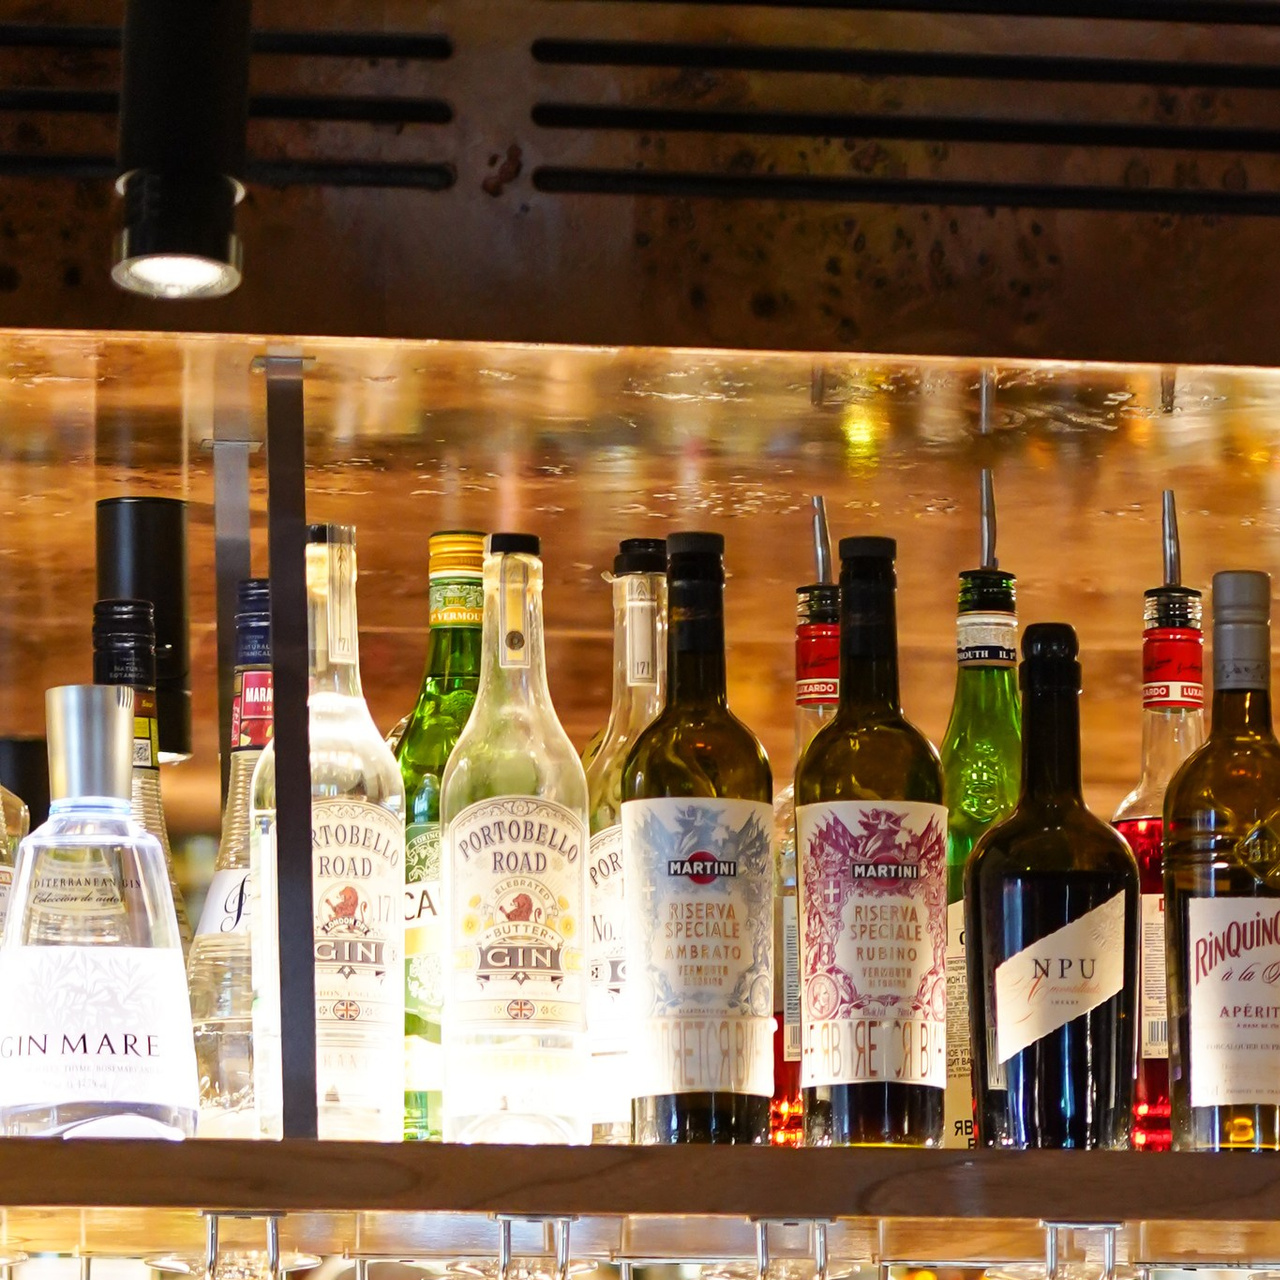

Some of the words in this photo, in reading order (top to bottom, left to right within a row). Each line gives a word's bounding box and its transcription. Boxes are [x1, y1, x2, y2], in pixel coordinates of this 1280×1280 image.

[458, 818, 580, 864] PORTOBELLO
[318, 855, 373, 879] ROAD
[491, 851, 548, 875] ROAD
[669, 861, 736, 876] MARTINI
[853, 864, 918, 879] MARTINI
[122, 877, 142, 890] GIN
[668, 902, 736, 919] RISERVA
[854, 905, 918, 922] RISERVA
[493, 923, 549, 940] BUTTER
[665, 921, 740, 939] SPECIALE
[850, 924, 922, 941] SPECIALE
[314, 942, 377, 963] GIN
[486, 947, 553, 968] GIN
[664, 945, 741, 960] AMBRATO
[856, 946, 918, 962] RUBINO
[1032, 957, 1096, 980] NPU
[1221, 965, 1233, 982] à
[1238, 962, 1256, 982] la
[0, 1033, 49, 1059] GIN
[61, 1032, 161, 1058] MARE
